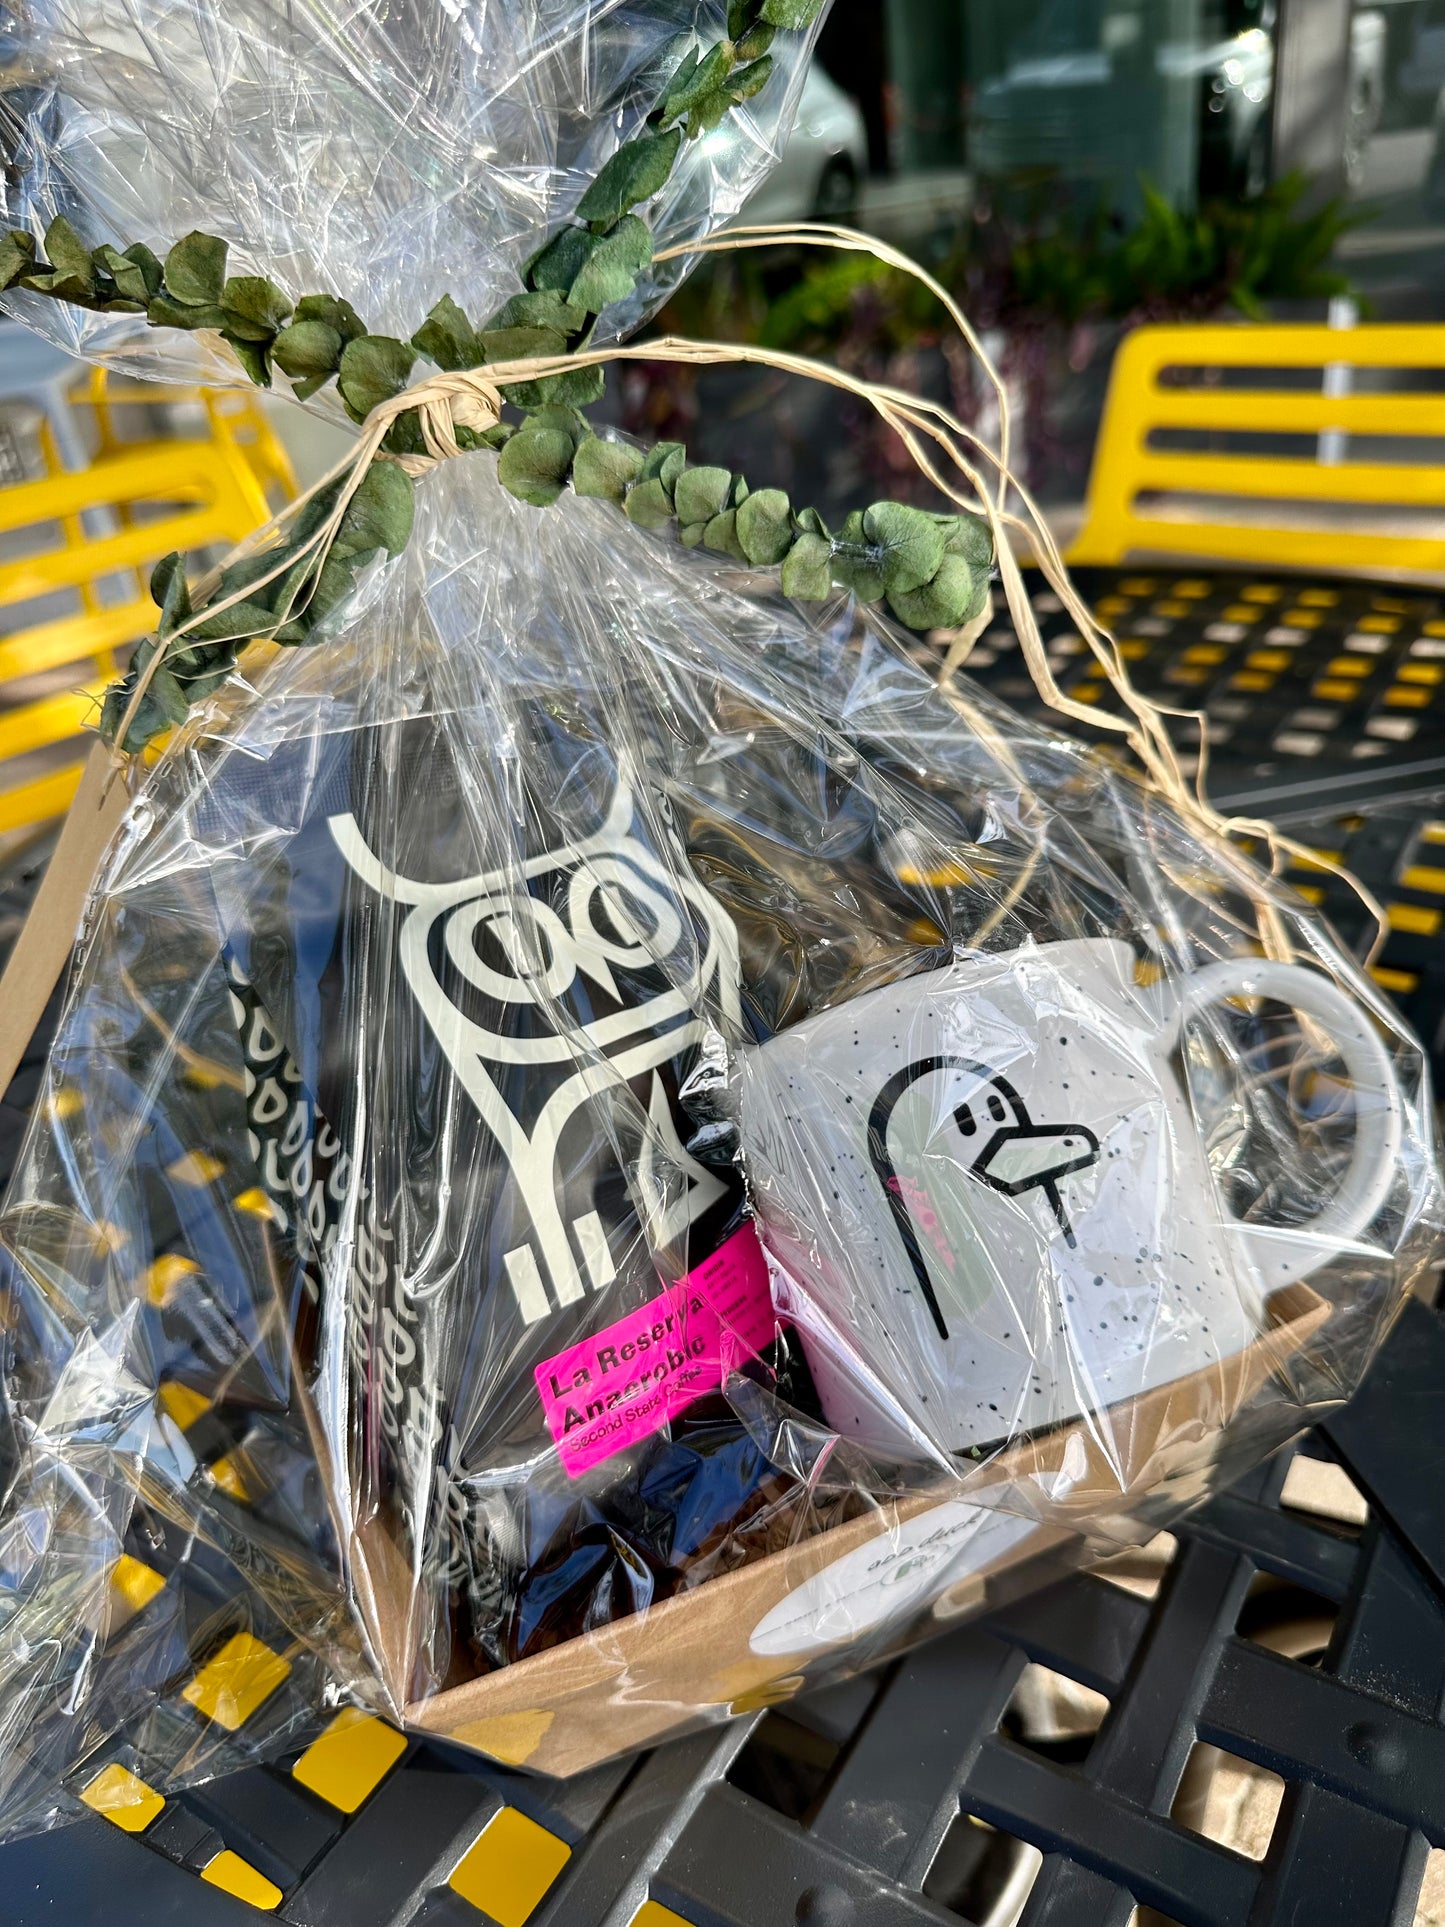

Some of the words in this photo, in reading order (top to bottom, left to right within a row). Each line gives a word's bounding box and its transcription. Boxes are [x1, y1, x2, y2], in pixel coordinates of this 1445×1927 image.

[550, 1366, 592, 1399] La
[597, 1297, 703, 1375] Reserva
[564, 1336, 705, 1433] Anaerobic
[570, 1416, 623, 1452] Second
[625, 1395, 662, 1422] State
[664, 1366, 703, 1398] Coffee
